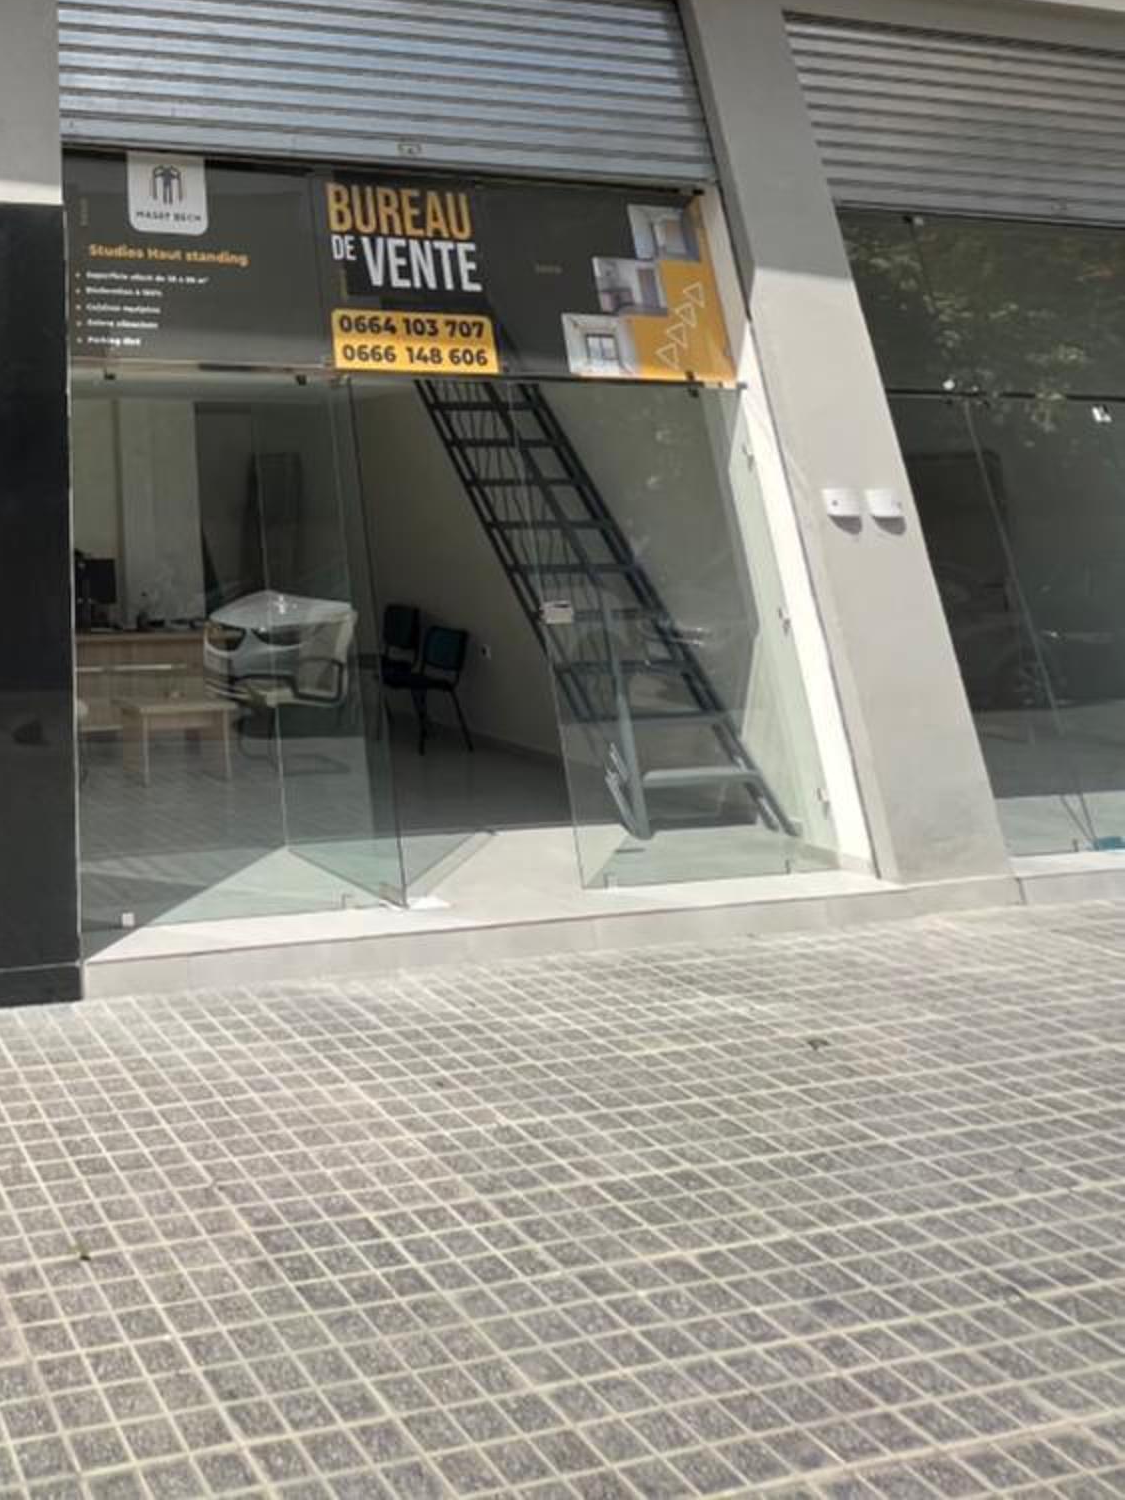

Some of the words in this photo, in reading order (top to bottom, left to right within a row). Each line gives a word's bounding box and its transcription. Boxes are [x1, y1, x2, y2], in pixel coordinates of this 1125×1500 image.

[326, 182, 472, 240] BUREAU
[89, 243, 144, 259] Studios
[146, 247, 182, 260] Haut
[186, 250, 250, 267] standing
[331, 235, 357, 261] DE
[360, 236, 483, 292] VENTE
[339, 315, 397, 336] 0664
[402, 317, 439, 337] 103
[444, 320, 485, 338] 707
[342, 345, 396, 363] 0666
[405, 346, 443, 364] 148
[449, 349, 488, 366] 606
